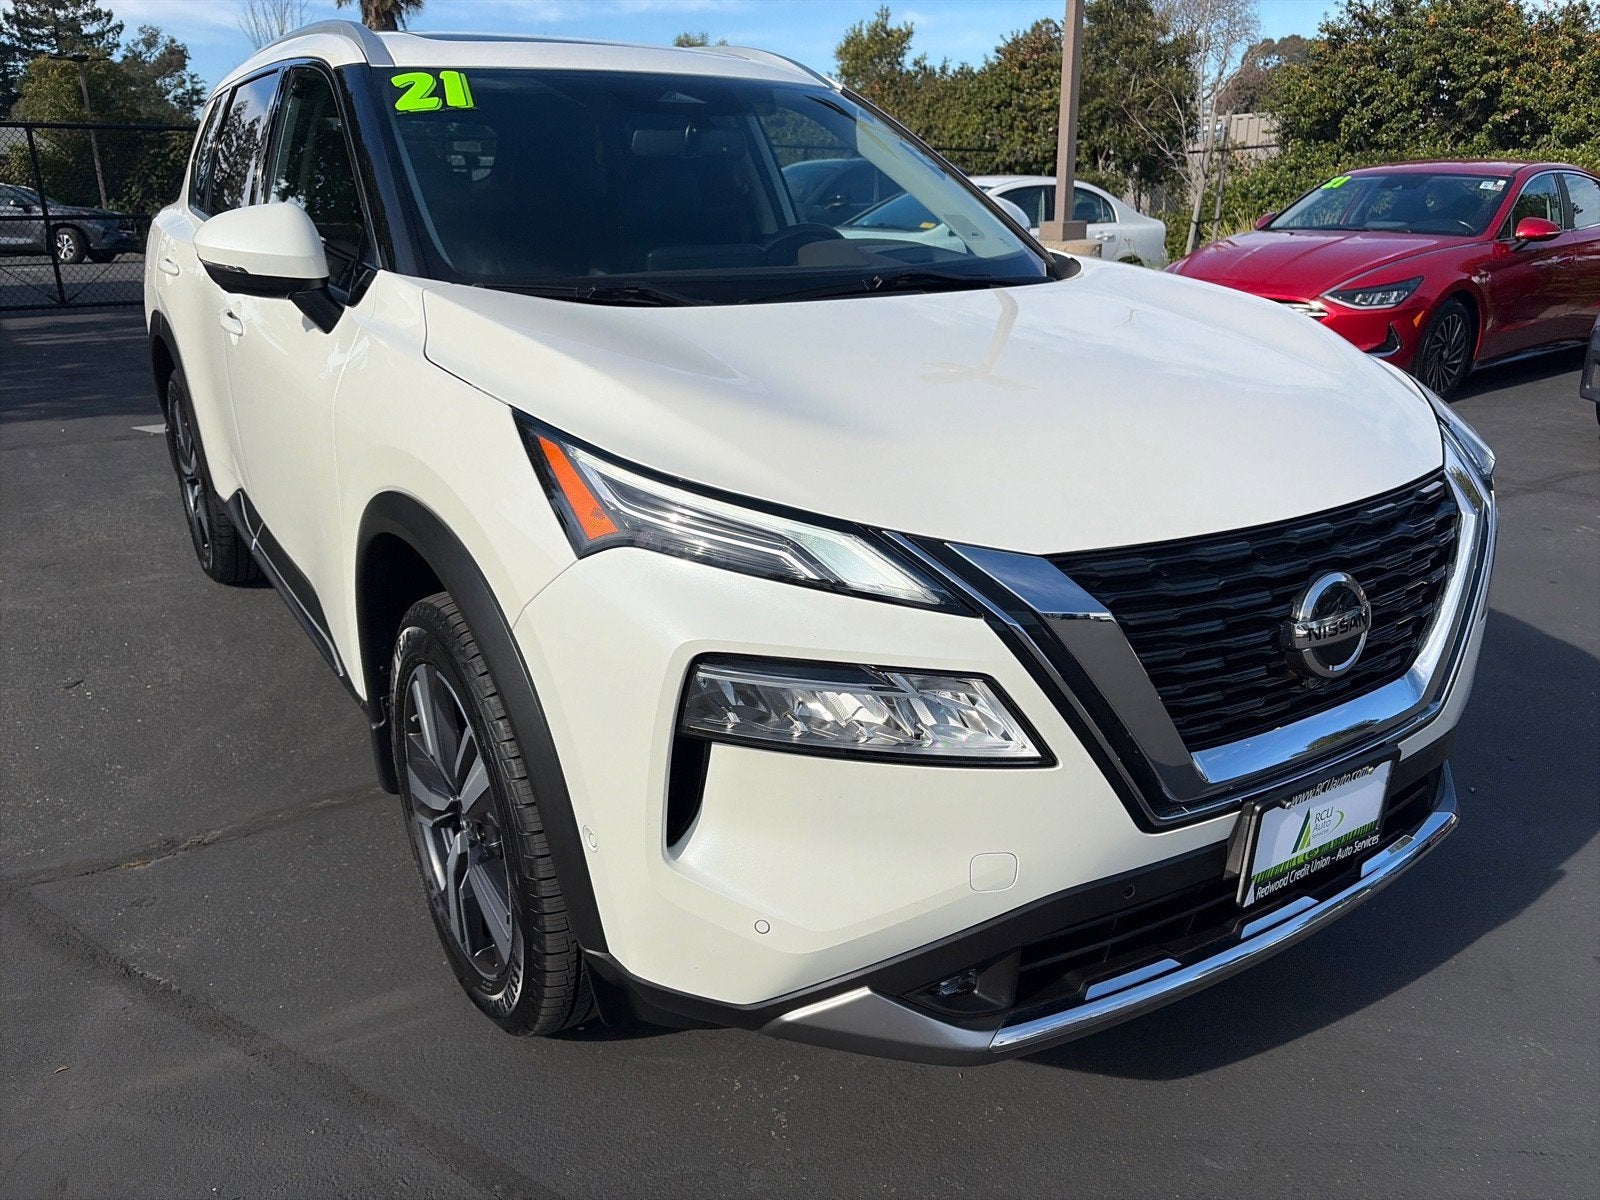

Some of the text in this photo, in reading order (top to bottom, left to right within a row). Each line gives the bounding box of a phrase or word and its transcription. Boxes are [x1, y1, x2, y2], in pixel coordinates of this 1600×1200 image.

[391, 70, 474, 112] 21
[1308, 613, 1367, 641] NISSAN
[1313, 820, 1331, 832] Auto
[1315, 806, 1334, 823] RCU
[1256, 874, 1290, 900] Redwood
[1289, 865, 1311, 883] Credit
[1311, 855, 1331, 872] Union
[1336, 845, 1353, 861] Auto
[1353, 834, 1380, 853] Services
